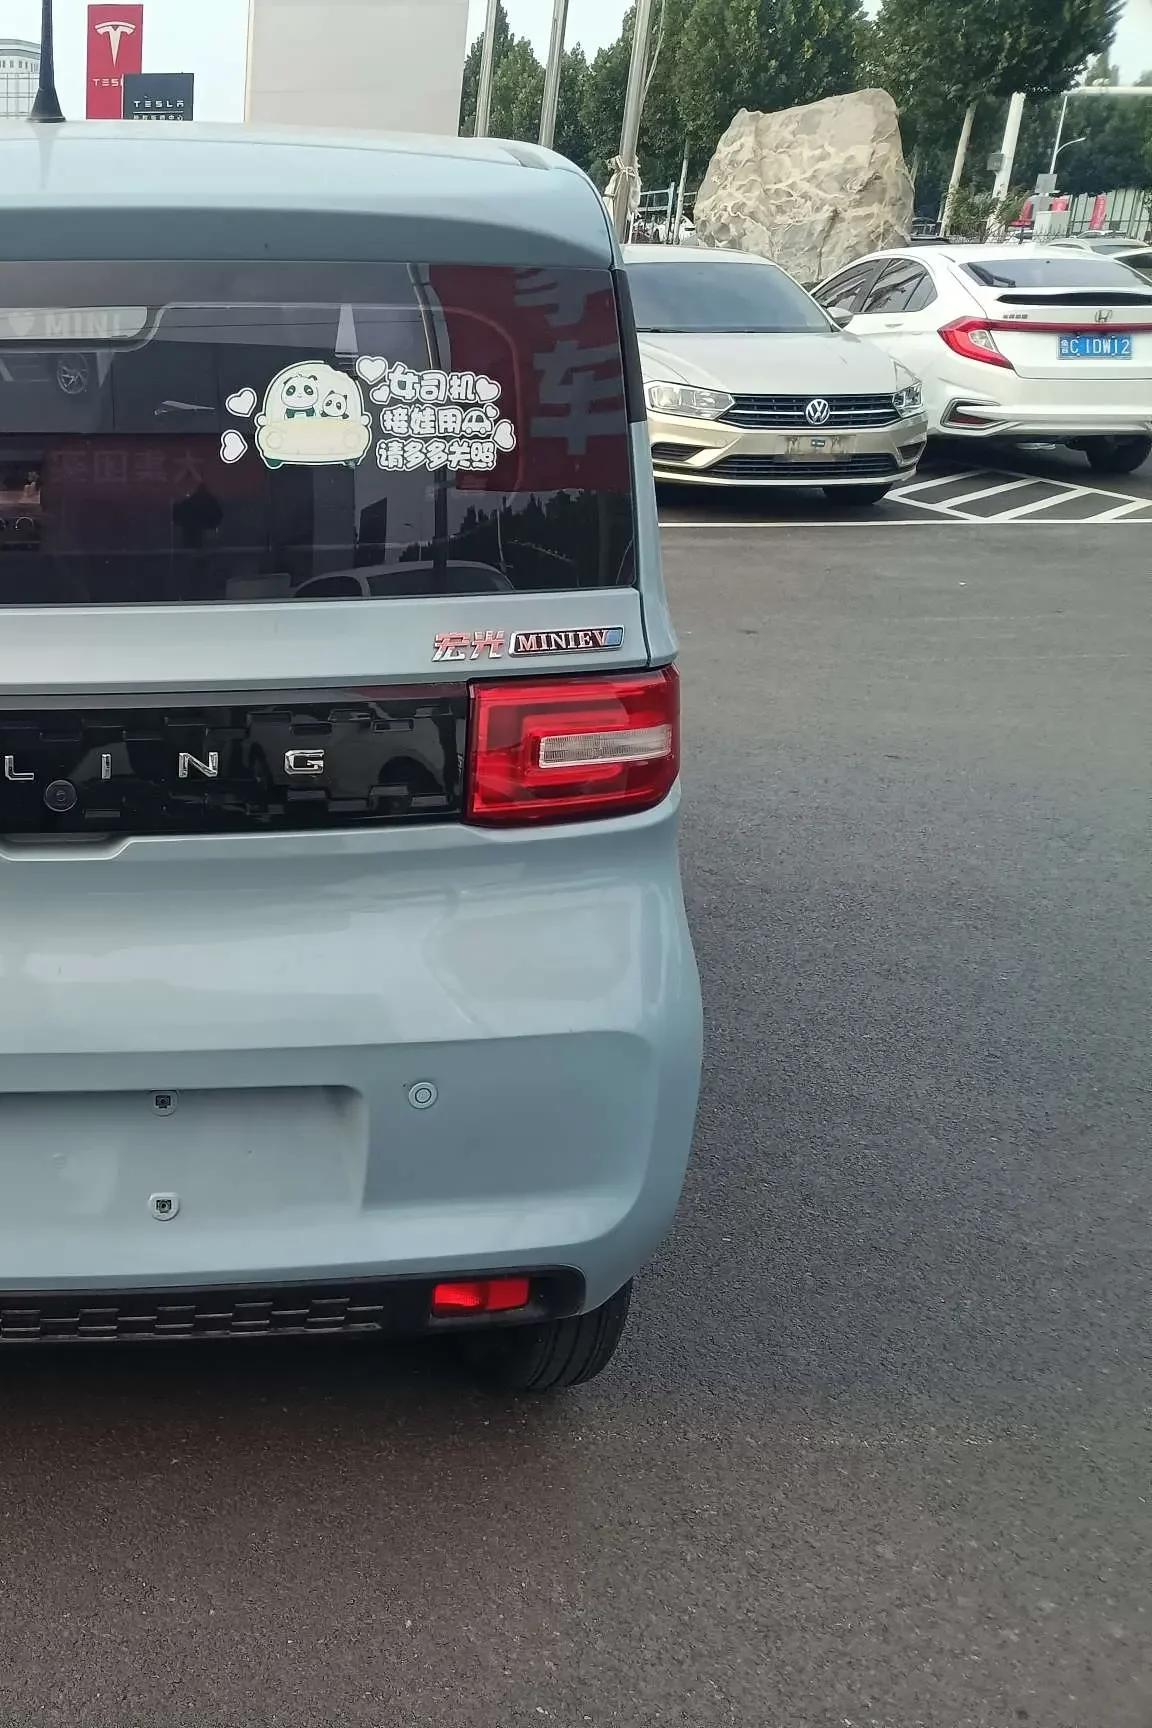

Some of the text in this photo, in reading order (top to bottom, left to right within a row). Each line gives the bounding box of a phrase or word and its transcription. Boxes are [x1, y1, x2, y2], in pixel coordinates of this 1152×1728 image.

[133, 100, 184, 108] TESLA
[386, 363, 477, 402] 女司机
[381, 404, 463, 436] 接娃用
[376, 438, 496, 471] 请多多关照
[432, 630, 506, 662] 宏光
[517, 630, 609, 652] MINIEV
